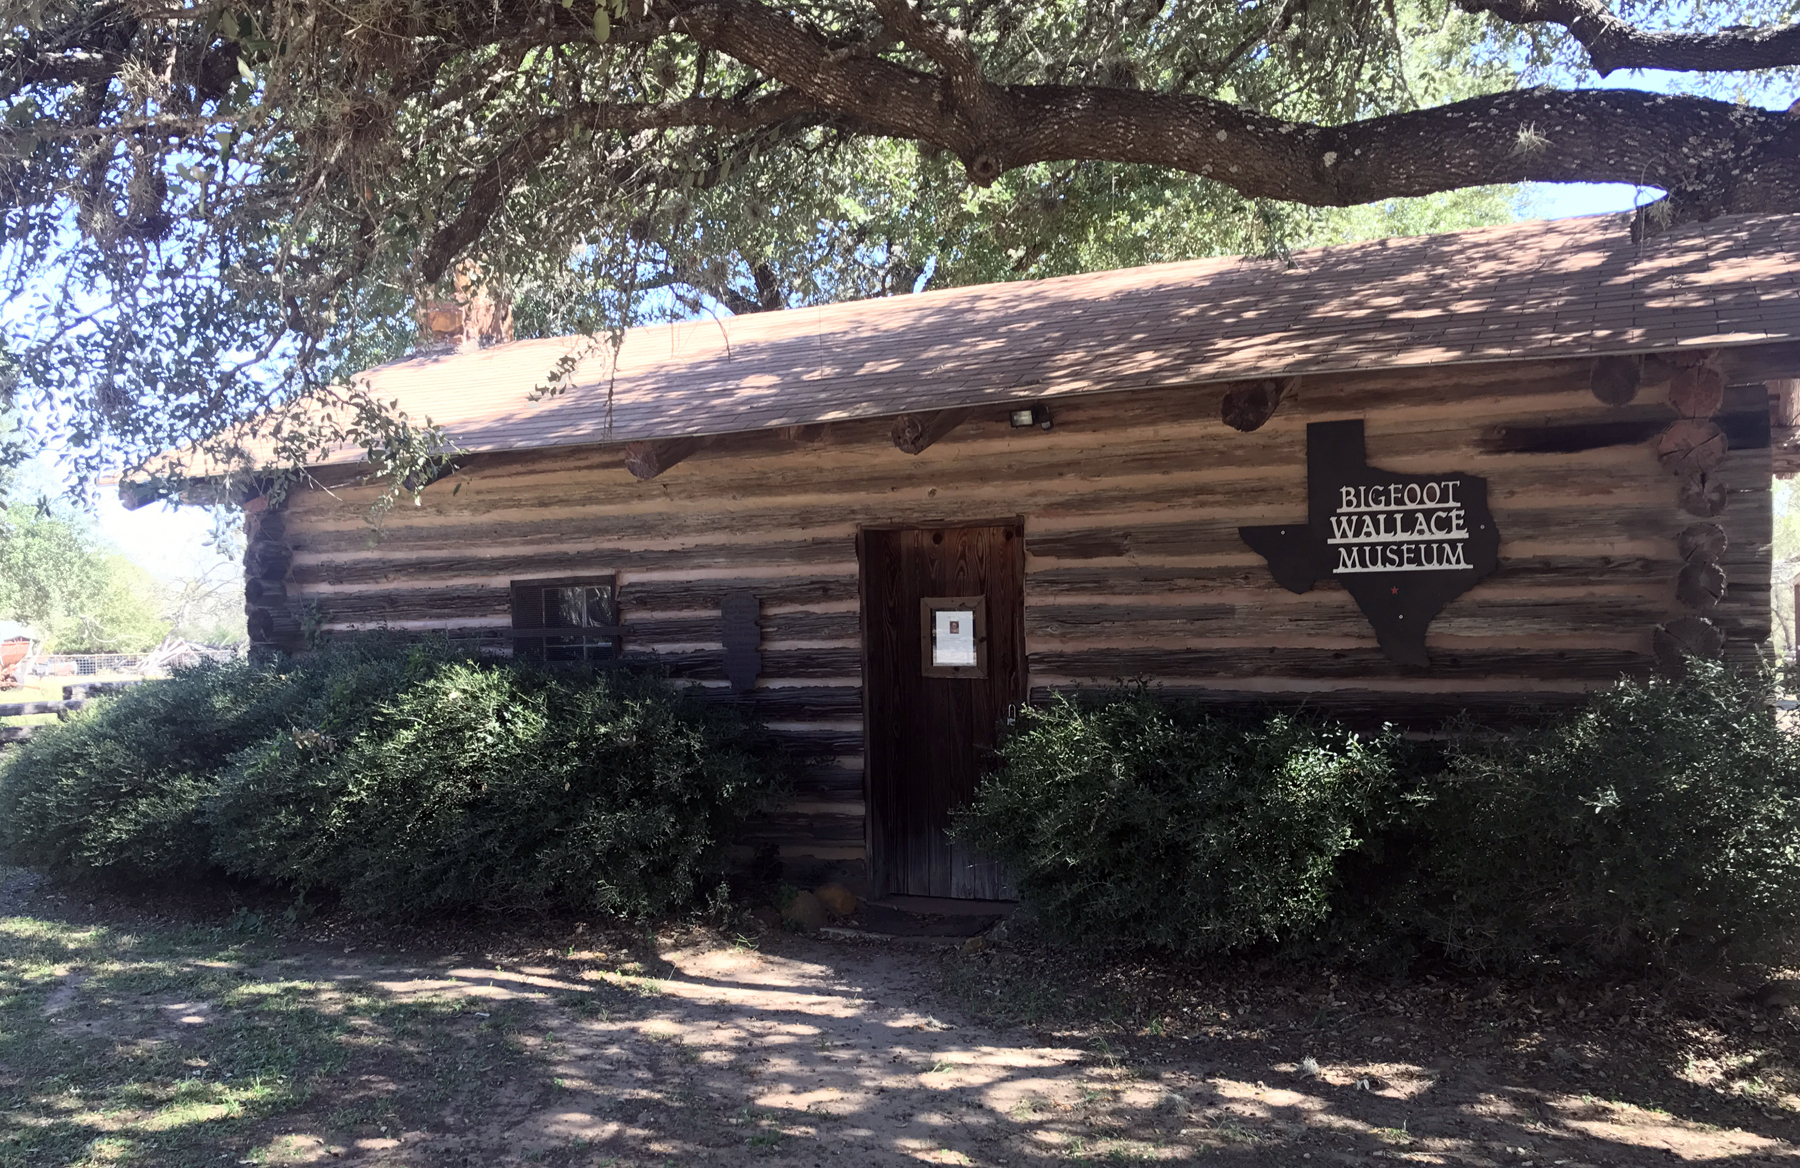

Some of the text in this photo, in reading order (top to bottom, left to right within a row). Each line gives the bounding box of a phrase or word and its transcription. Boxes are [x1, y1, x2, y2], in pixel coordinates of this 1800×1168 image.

[1339, 480, 1461, 510] BIGFOOT
[1330, 509, 1468, 540] WALLACE
[1338, 543, 1466, 570] MUSEUM
